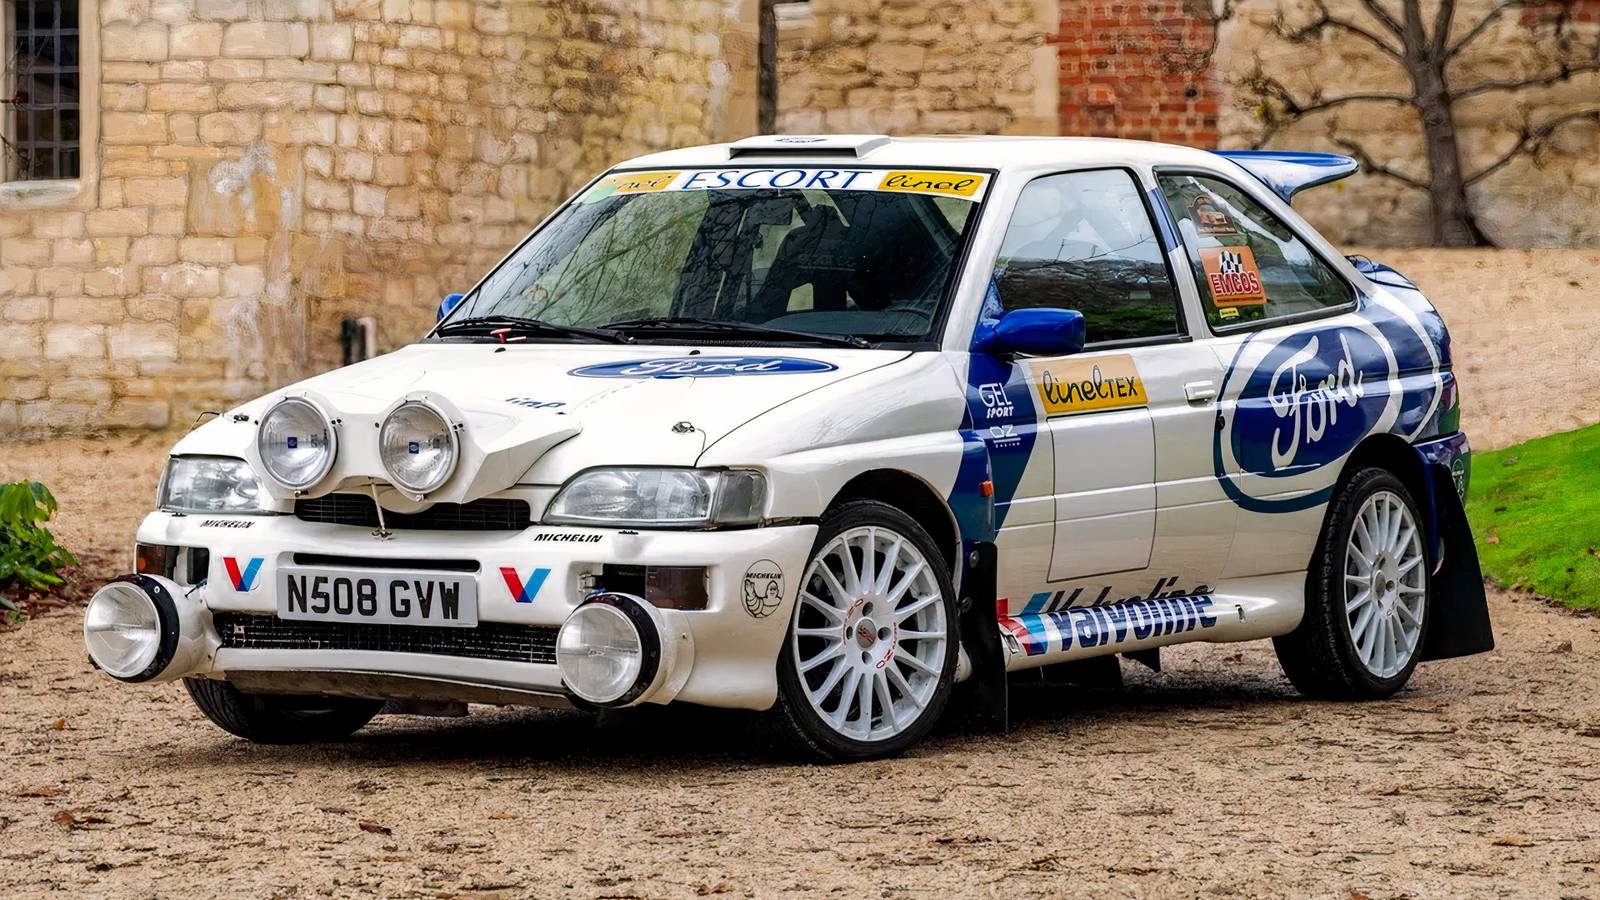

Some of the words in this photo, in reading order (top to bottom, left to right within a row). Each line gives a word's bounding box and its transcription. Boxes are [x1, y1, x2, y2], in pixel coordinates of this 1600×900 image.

[682, 170, 872, 189] ESCORT
[886, 174, 975, 192] linel
[1209, 271, 1262, 296] EMCOS
[620, 357, 783, 375] Ford
[979, 382, 1012, 407] GEL
[1268, 333, 1364, 471] Ford
[986, 406, 1014, 419] SPORT
[533, 533, 603, 543] MICHELIN
[287, 574, 377, 616] N508
[389, 579, 460, 620] GVW
